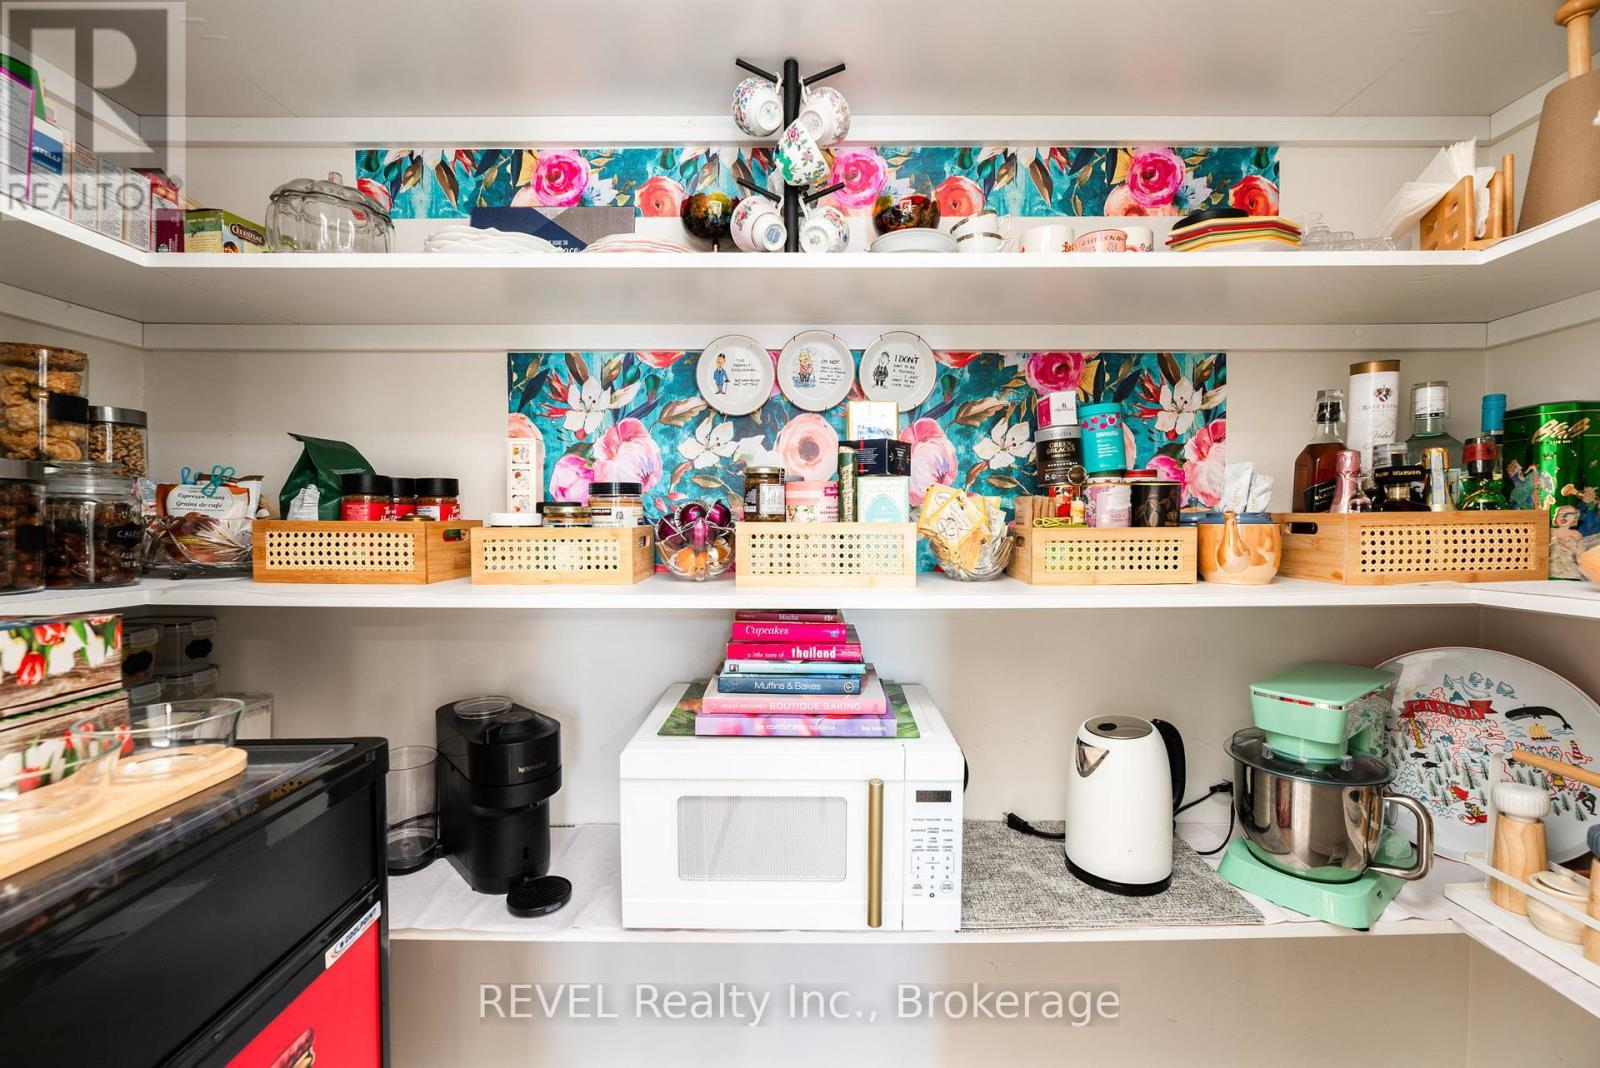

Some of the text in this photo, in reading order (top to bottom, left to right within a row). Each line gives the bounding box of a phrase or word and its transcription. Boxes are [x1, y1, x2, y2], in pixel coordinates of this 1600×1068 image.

[745, 625, 790, 637] Cupcakes
[791, 646, 837, 659] thailand
[770, 702, 820, 711] BOUTIQUE
[823, 702, 860, 711] BAKING
[1413, 701, 1480, 719] CANADA
